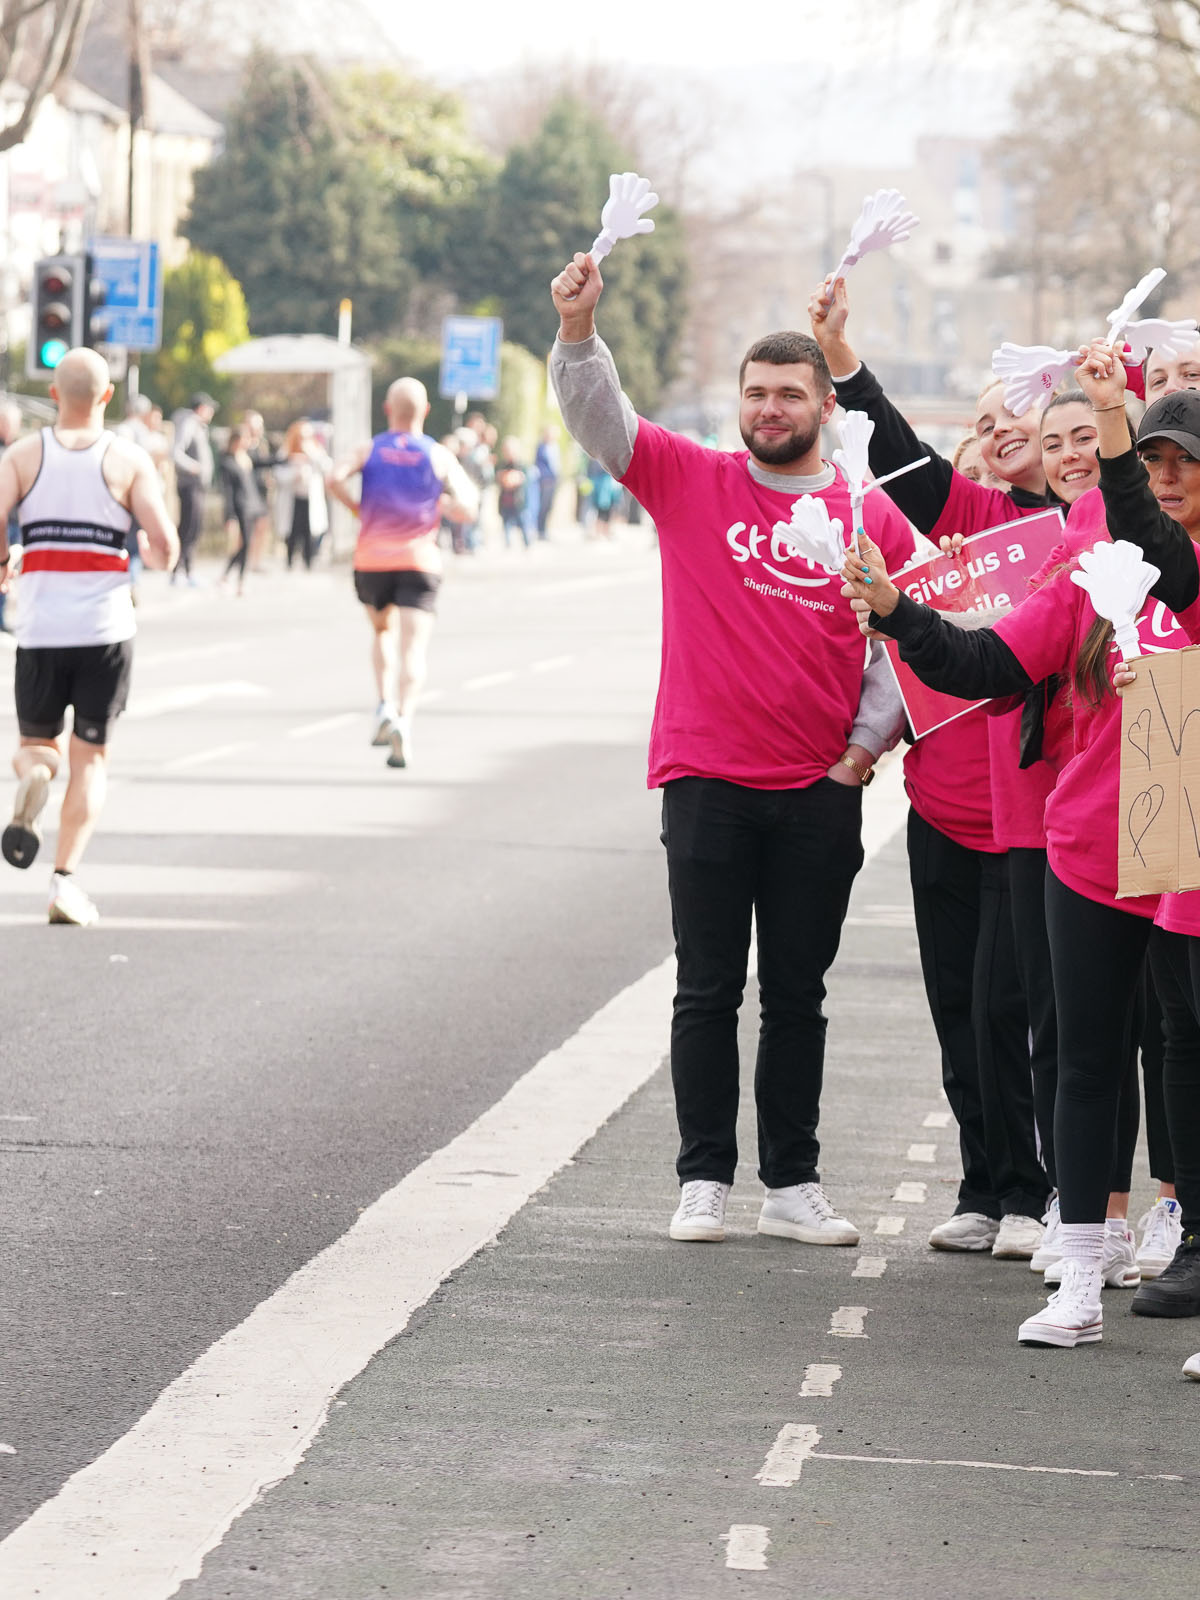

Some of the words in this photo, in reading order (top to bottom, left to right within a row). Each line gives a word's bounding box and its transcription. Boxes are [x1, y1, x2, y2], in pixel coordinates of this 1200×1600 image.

[726, 521, 767, 563] St
[904, 569, 963, 605] Give
[966, 551, 1001, 579] us
[1006, 543, 1026, 563] a
[743, 577, 794, 602] Sheffield's
[795, 594, 835, 613] Hospice
[961, 592, 1012, 615] ile
